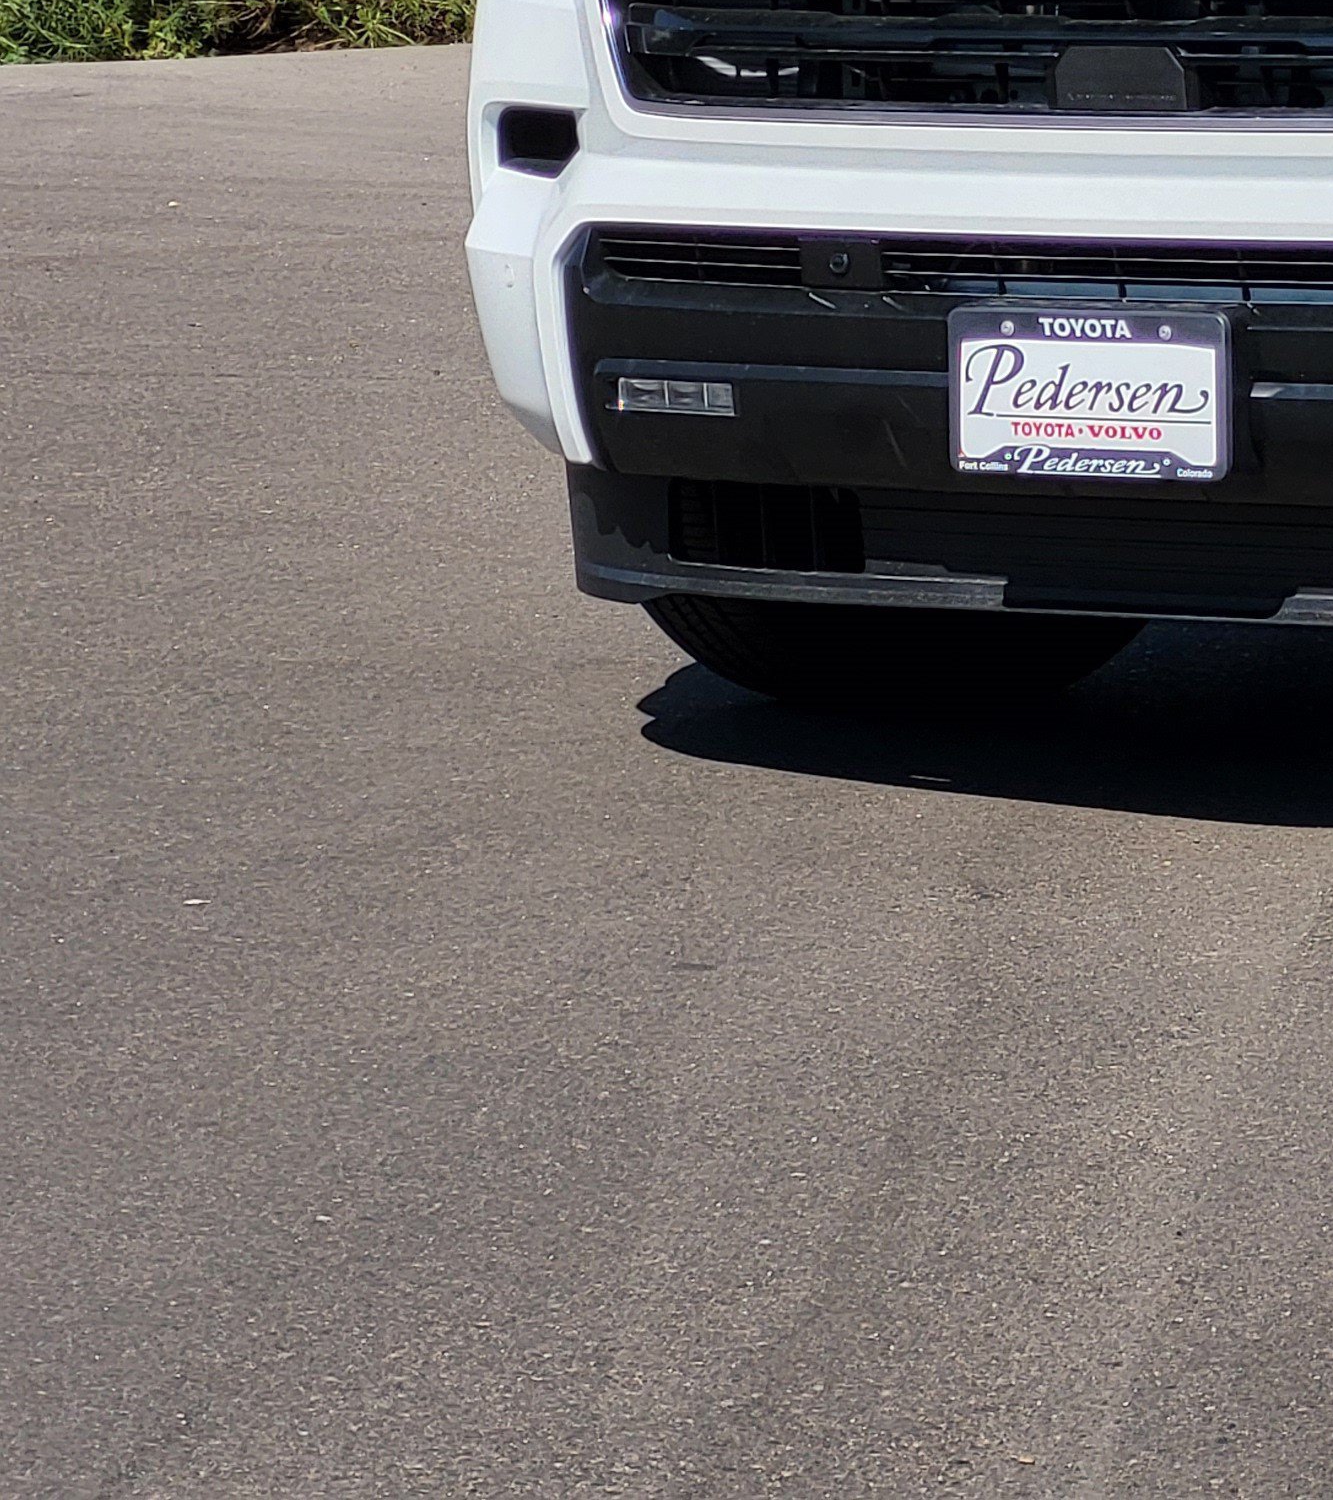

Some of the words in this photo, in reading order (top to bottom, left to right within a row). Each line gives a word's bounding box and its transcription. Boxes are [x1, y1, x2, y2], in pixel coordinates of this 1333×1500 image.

[1039, 317, 1132, 339] TOYOTA
[965, 344, 1210, 417] Pedersen
[1011, 422, 1075, 438] TOYOTA
[1087, 424, 1162, 441] VOLVO
[1014, 444, 1161, 474] Pedersen
[1176, 467, 1213, 479] Colorado
